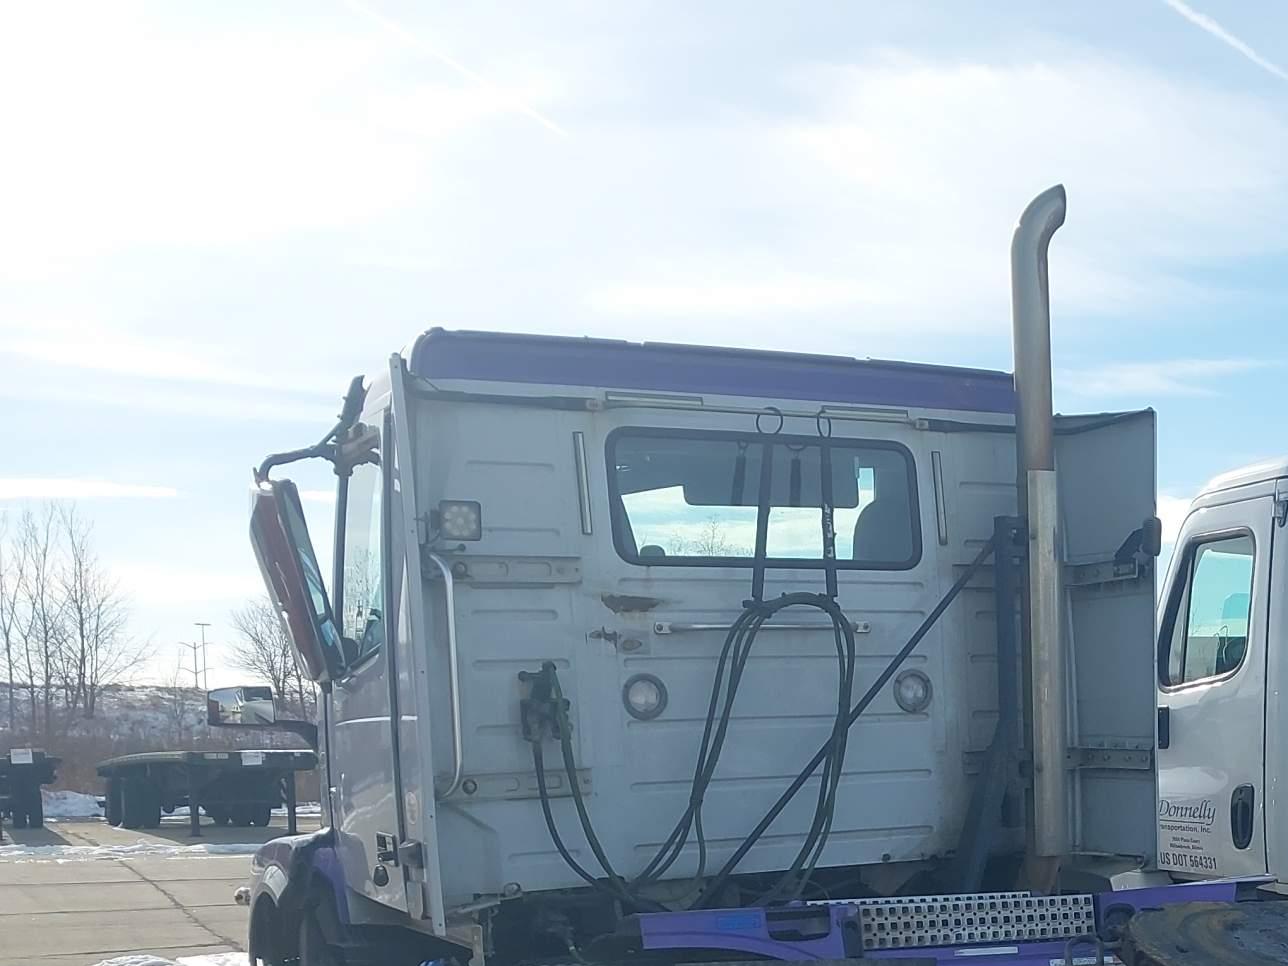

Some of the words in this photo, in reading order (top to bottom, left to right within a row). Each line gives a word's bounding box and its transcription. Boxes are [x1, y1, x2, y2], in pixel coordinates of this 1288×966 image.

[1160, 799, 1216, 826] Donnelly
[1160, 851, 1171, 865] US
[1172, 852, 1188, 867] DOT
[1189, 854, 1218, 870] 564331
